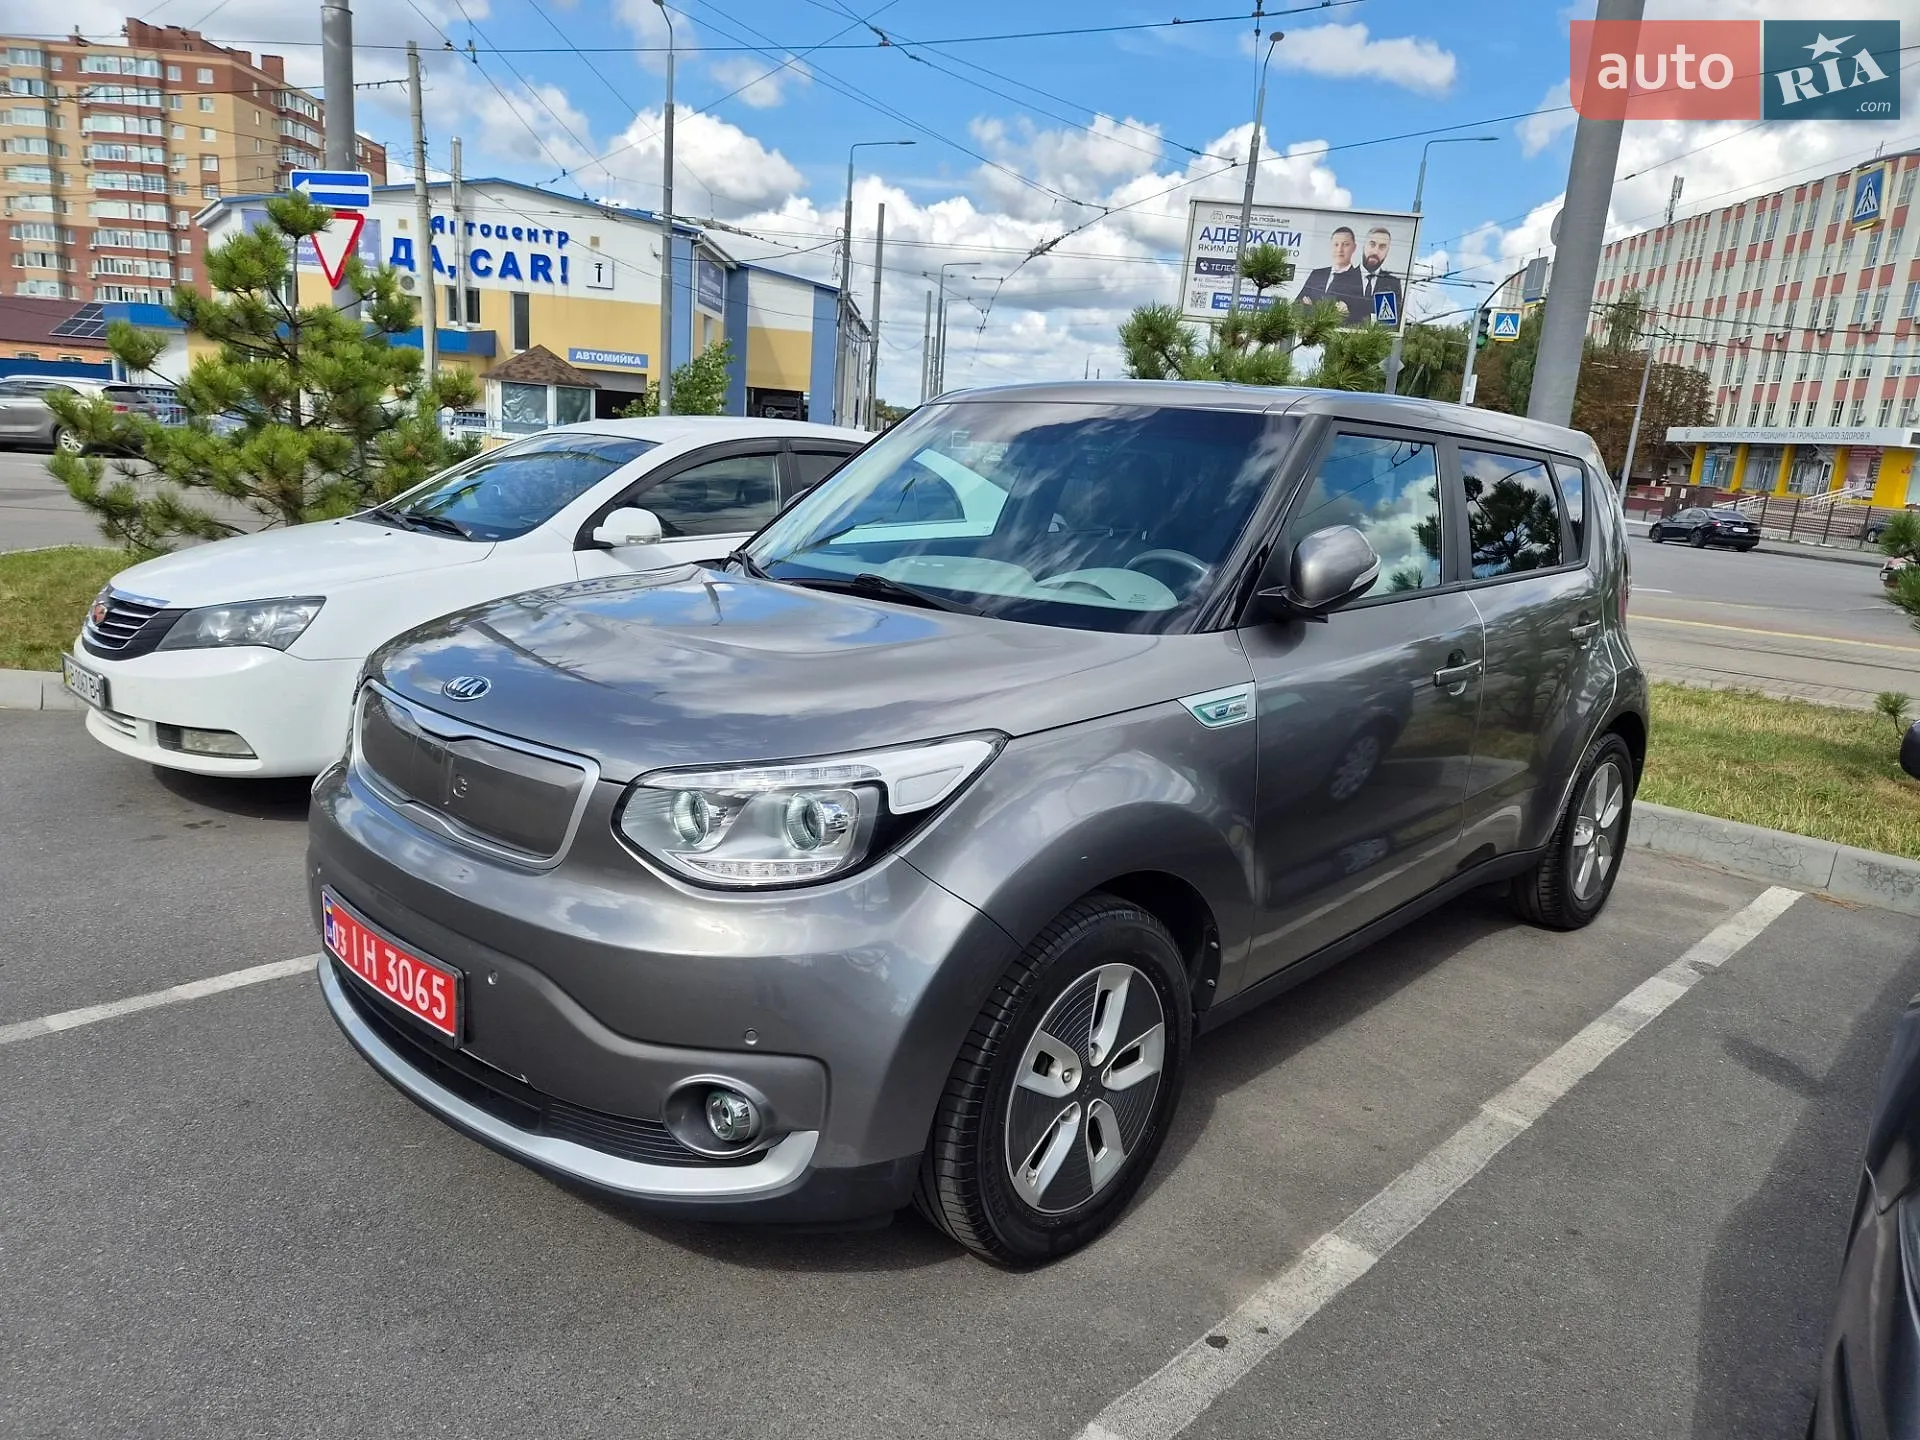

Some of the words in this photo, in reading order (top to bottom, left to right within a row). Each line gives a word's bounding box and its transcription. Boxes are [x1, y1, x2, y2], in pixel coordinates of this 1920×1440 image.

[1198, 243, 1225, 253] ЯКИМ
[469, 248, 569, 285] CAR!
[575, 351, 641, 365] АВТОМИЙКА
[385, 950, 447, 1020] 3065
